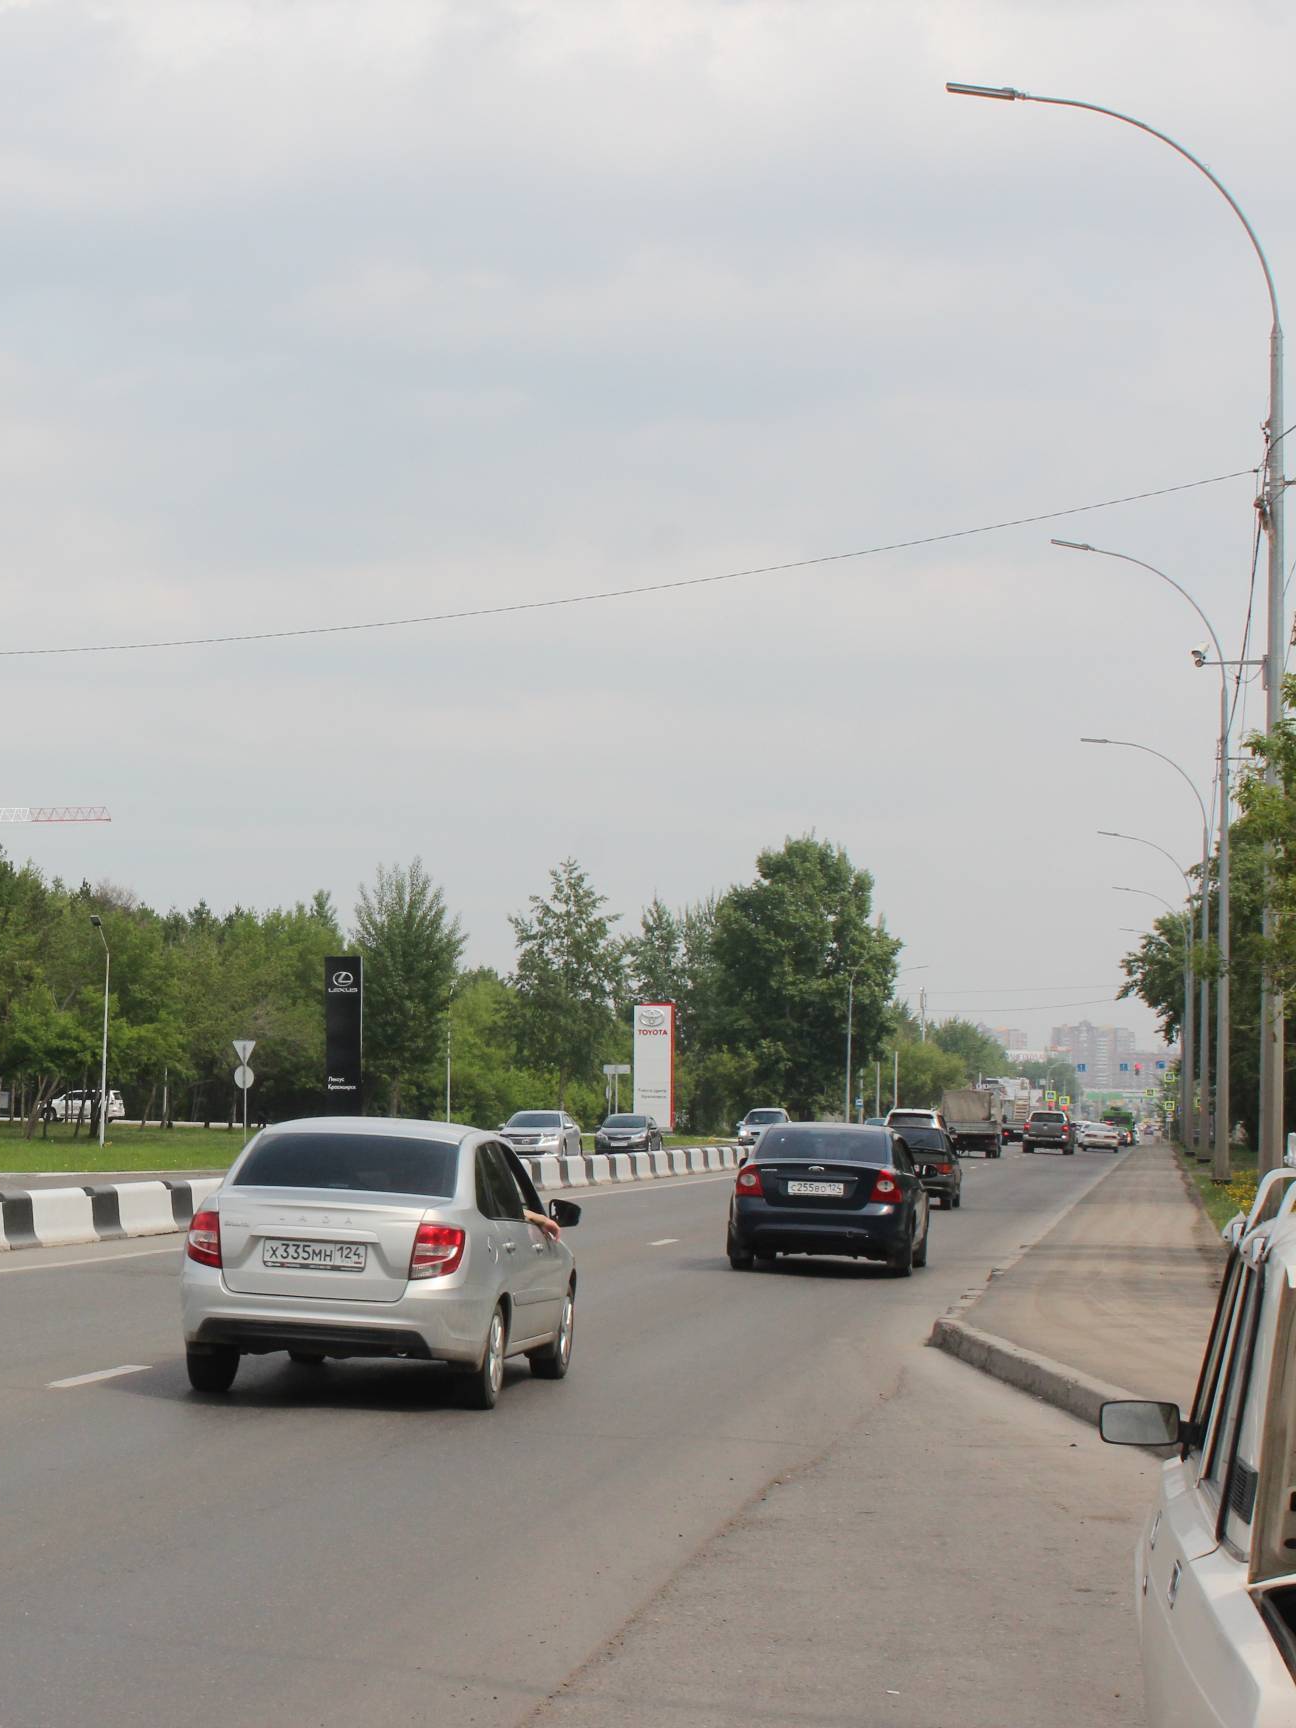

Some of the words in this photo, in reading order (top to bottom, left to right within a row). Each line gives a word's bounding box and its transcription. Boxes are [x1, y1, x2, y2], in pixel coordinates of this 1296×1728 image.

[790, 1182, 826, 1193] С255ВО
[828, 1183, 842, 1191] 124
[269, 1243, 333, 1262] Х335МН
[337, 1245, 361, 1260] 124
